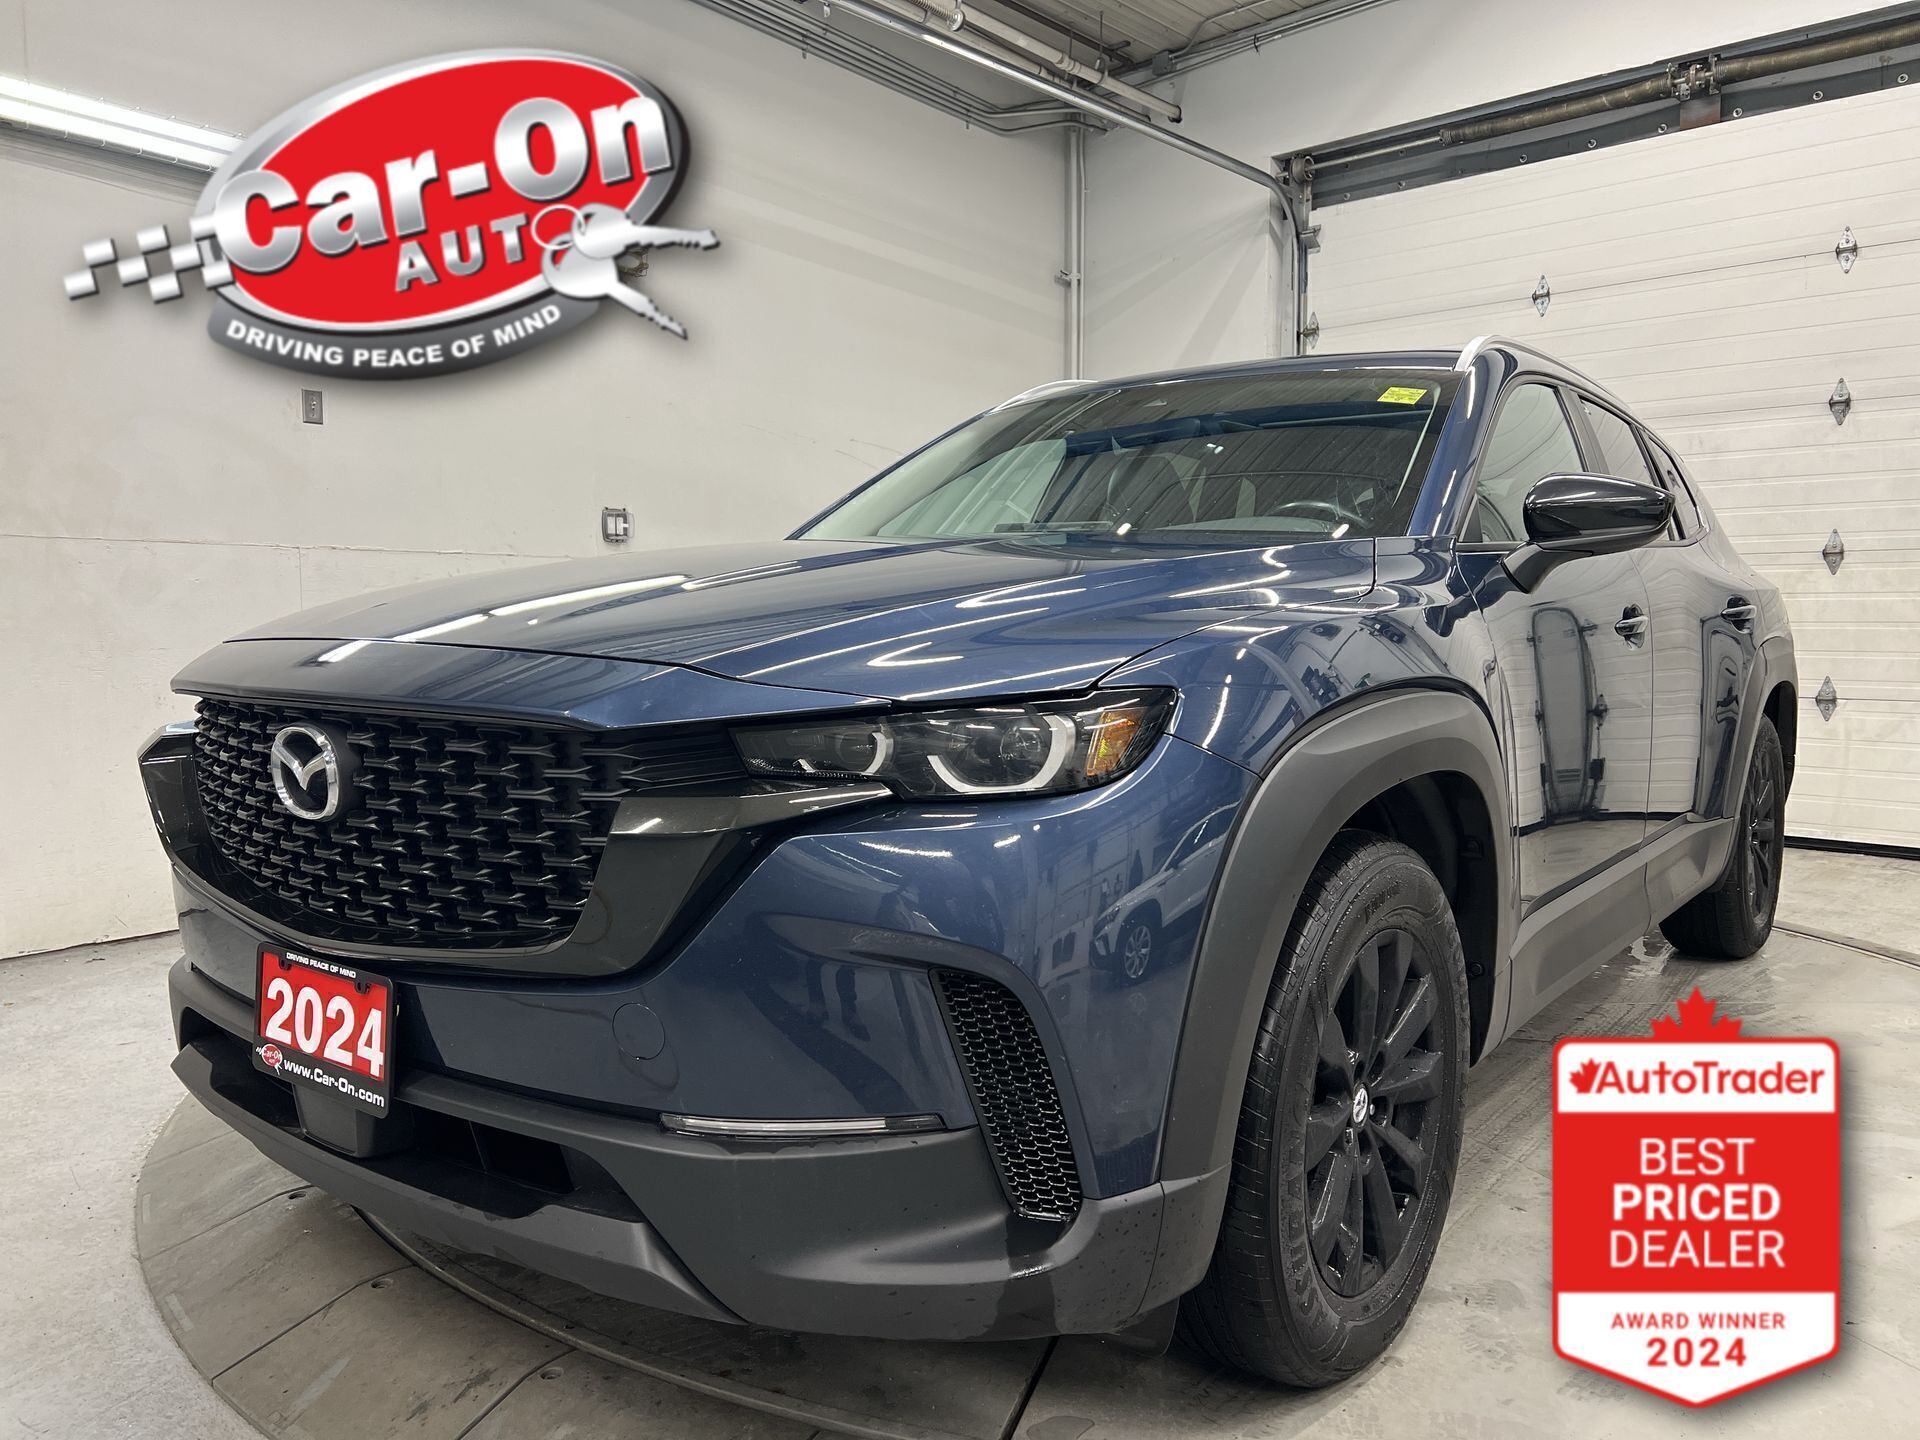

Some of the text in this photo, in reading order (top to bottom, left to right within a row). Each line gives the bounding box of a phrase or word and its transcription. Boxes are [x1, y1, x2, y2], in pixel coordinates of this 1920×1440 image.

[286, 952, 357, 979] DRIVING PEACE OF MIND
[265, 977, 384, 1077] 2024
[283, 1059, 385, 1108] www.Car-On.com
